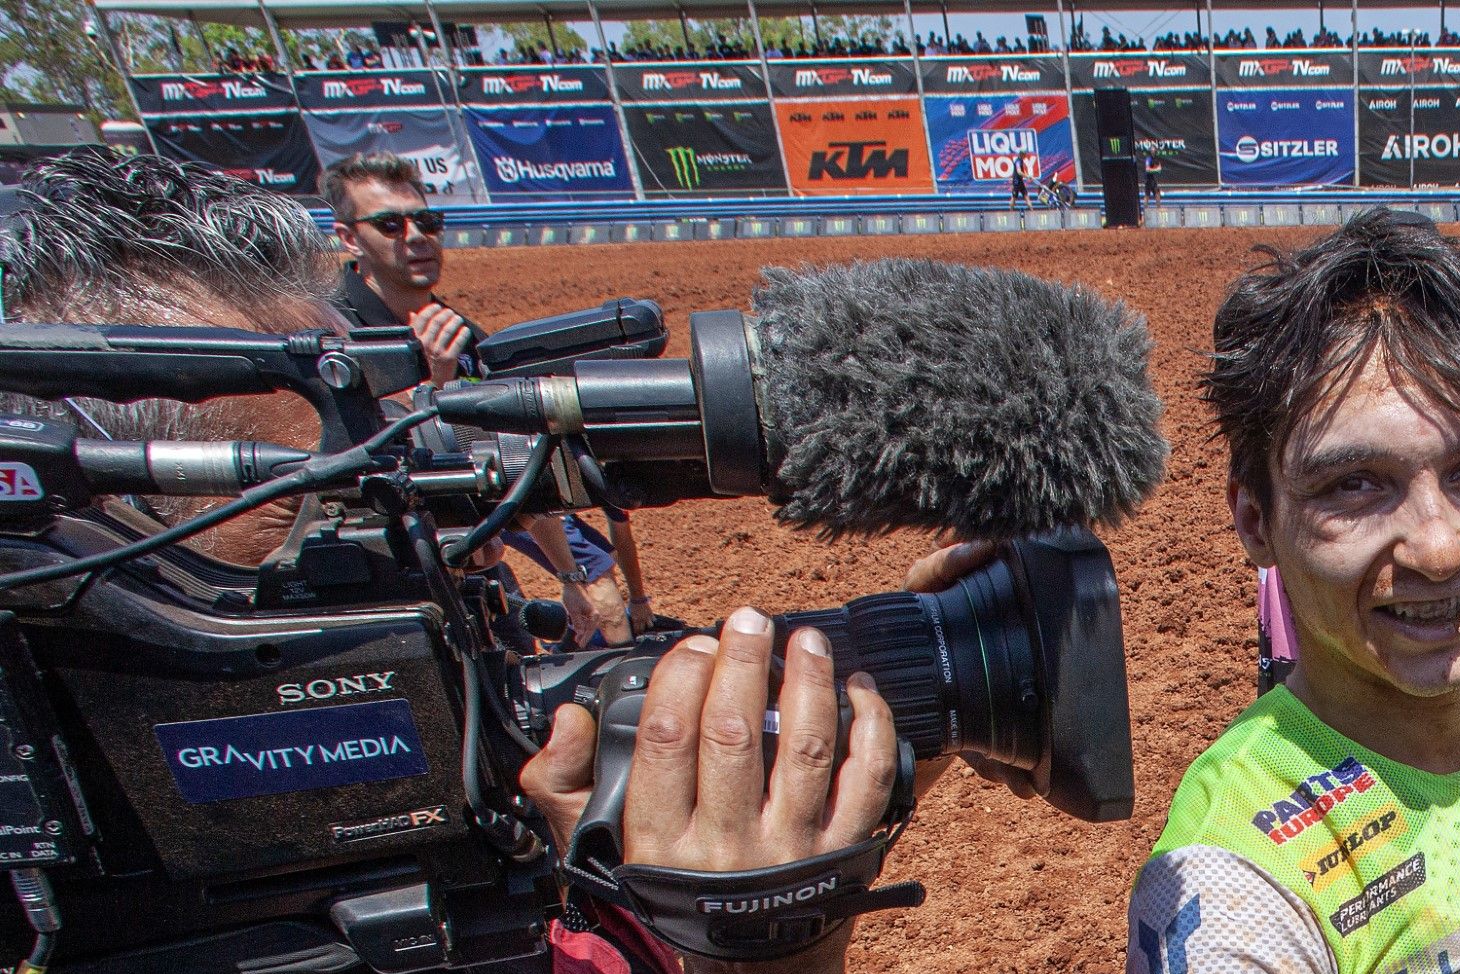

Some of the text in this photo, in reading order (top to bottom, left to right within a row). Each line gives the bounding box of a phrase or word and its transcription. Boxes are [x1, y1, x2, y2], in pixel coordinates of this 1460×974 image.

[1369, 99, 1397, 110] AIROH
[1413, 98, 1440, 109] AIROH
[971, 131, 1034, 155] LIQUI
[1260, 140, 1339, 158] SITZLER
[423, 157, 448, 174] US
[516, 158, 614, 181] Husqvarna
[808, 141, 909, 181] KTM
[975, 156, 1037, 179] MOY
[934, 625, 953, 684] CORPORATION
[276, 671, 396, 705] SONY
[178, 735, 412, 771] GRAVITY MEDIA
[1251, 756, 1371, 835] PARTS
[410, 807, 446, 827] FX
[1267, 771, 1377, 846] EUROPE
[703, 877, 836, 914] FUJINON
